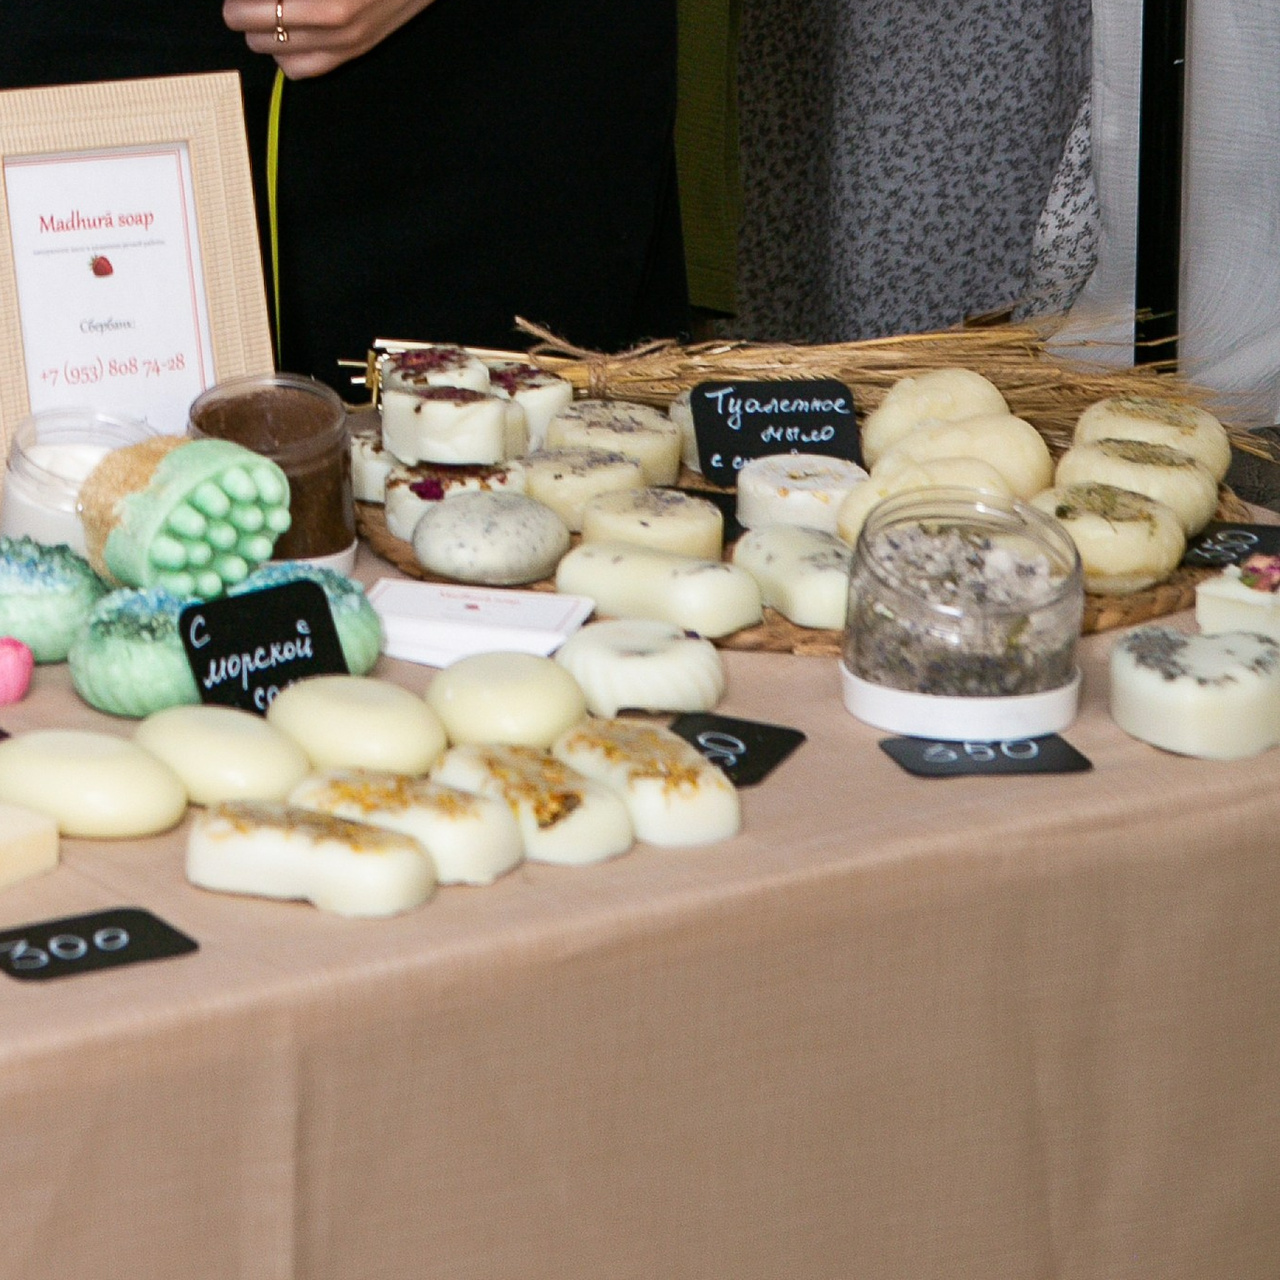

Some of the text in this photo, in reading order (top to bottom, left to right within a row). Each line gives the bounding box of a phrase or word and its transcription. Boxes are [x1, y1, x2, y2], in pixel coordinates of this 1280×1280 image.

[117, 210, 154, 231] soap
[40, 352, 186, 387] +7 (953) 808 74-28
[703, 386, 851, 431] Туалетное
[189, 614, 211, 649] С
[202, 619, 314, 691] морской
